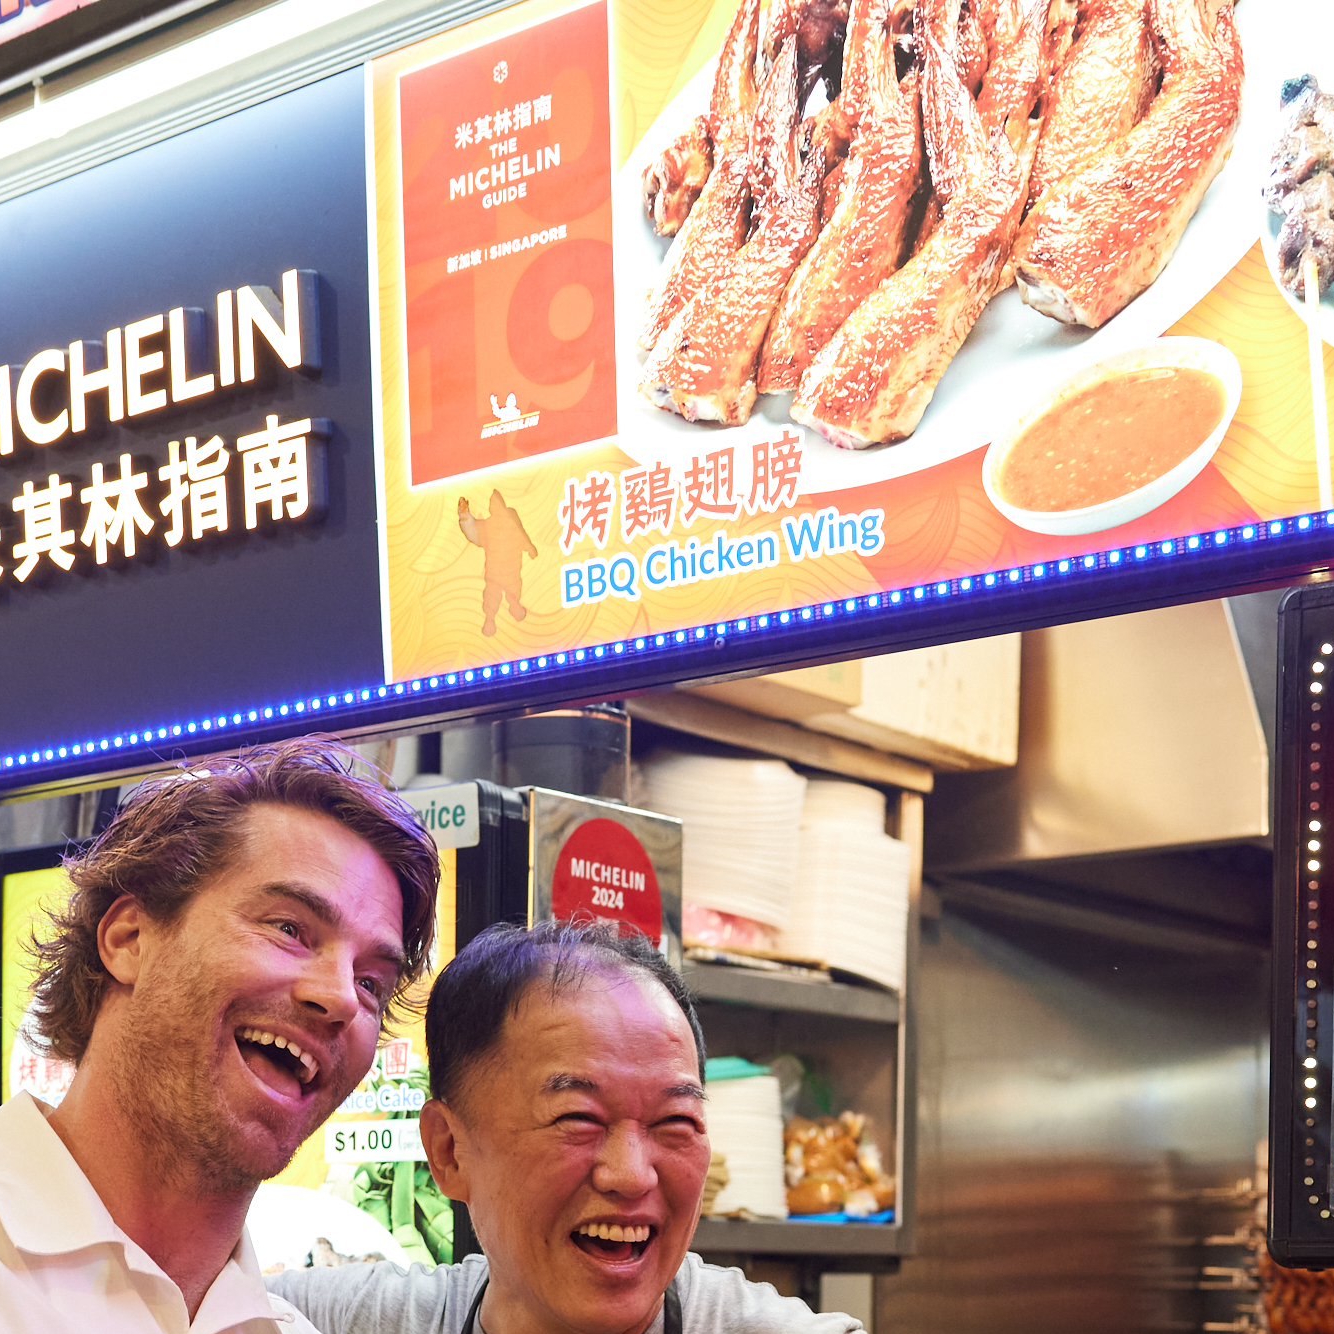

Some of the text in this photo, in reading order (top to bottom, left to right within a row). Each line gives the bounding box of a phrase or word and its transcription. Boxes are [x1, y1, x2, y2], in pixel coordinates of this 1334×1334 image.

[453, 93, 553, 150] 米其林指南
[489, 138, 518, 156] THE
[449, 143, 562, 200] MICHELIN
[481, 183, 527, 209] GUIDE
[446, 225, 567, 274] 新加坡 SINGAPORE
[481, 415, 540, 439] MICHELIN
[565, 509, 881, 605] BBQ Chicken Wing
[571, 857, 645, 893] MICHELIN
[591, 886, 624, 911] 2024
[379, 1086, 424, 1111] Cake
[335, 1130, 393, 1152] $1.00
